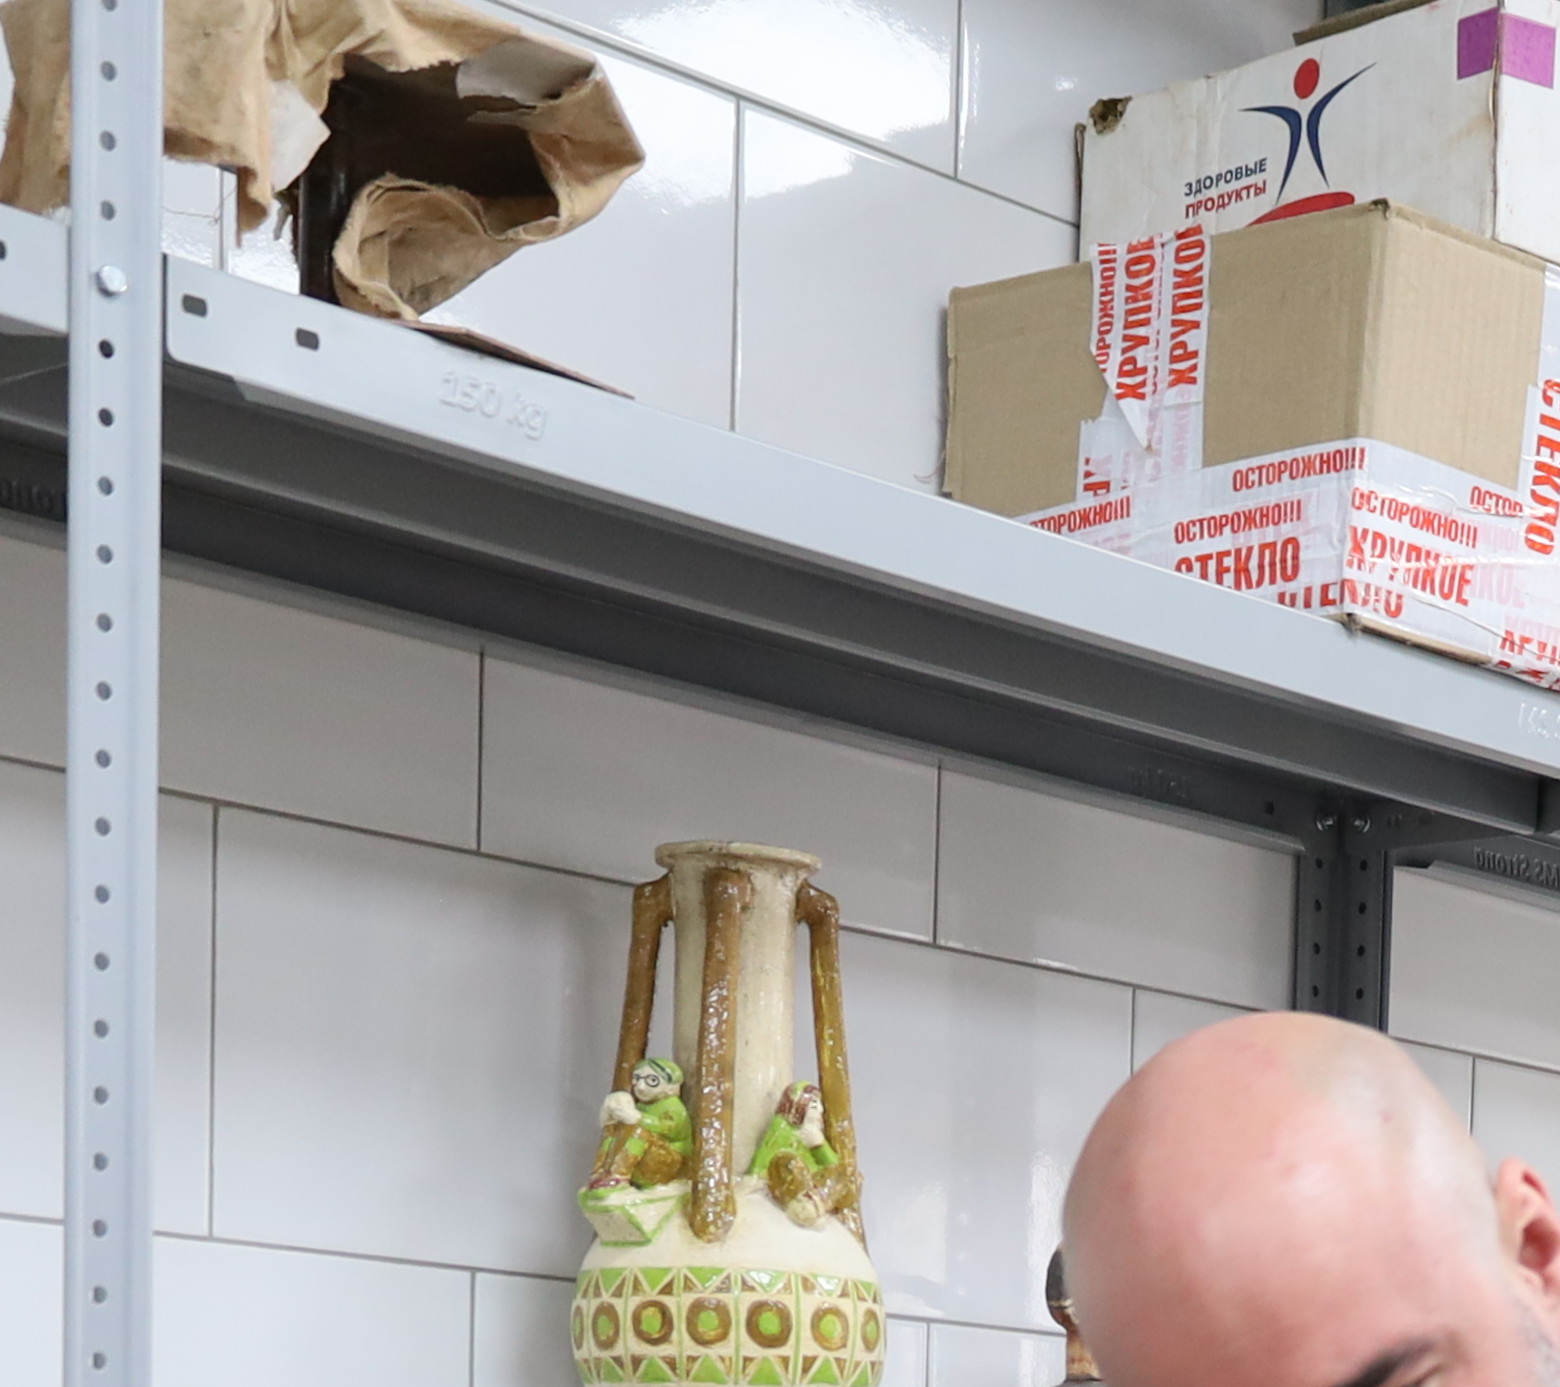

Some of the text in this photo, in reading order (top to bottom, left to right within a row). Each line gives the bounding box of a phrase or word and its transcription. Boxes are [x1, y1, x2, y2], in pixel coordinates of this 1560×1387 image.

[1184, 157, 1268, 197] ЗДОРОВЫЕ
[1185, 180, 1268, 219] ПРОДУКТЫ
[1232, 447, 1367, 492] ОСТОРОЖНО!!!
[1174, 499, 1302, 544] ОСТОРОЖНО!!!
[1351, 487, 1478, 549] ОСТОРОЖНО!!!
